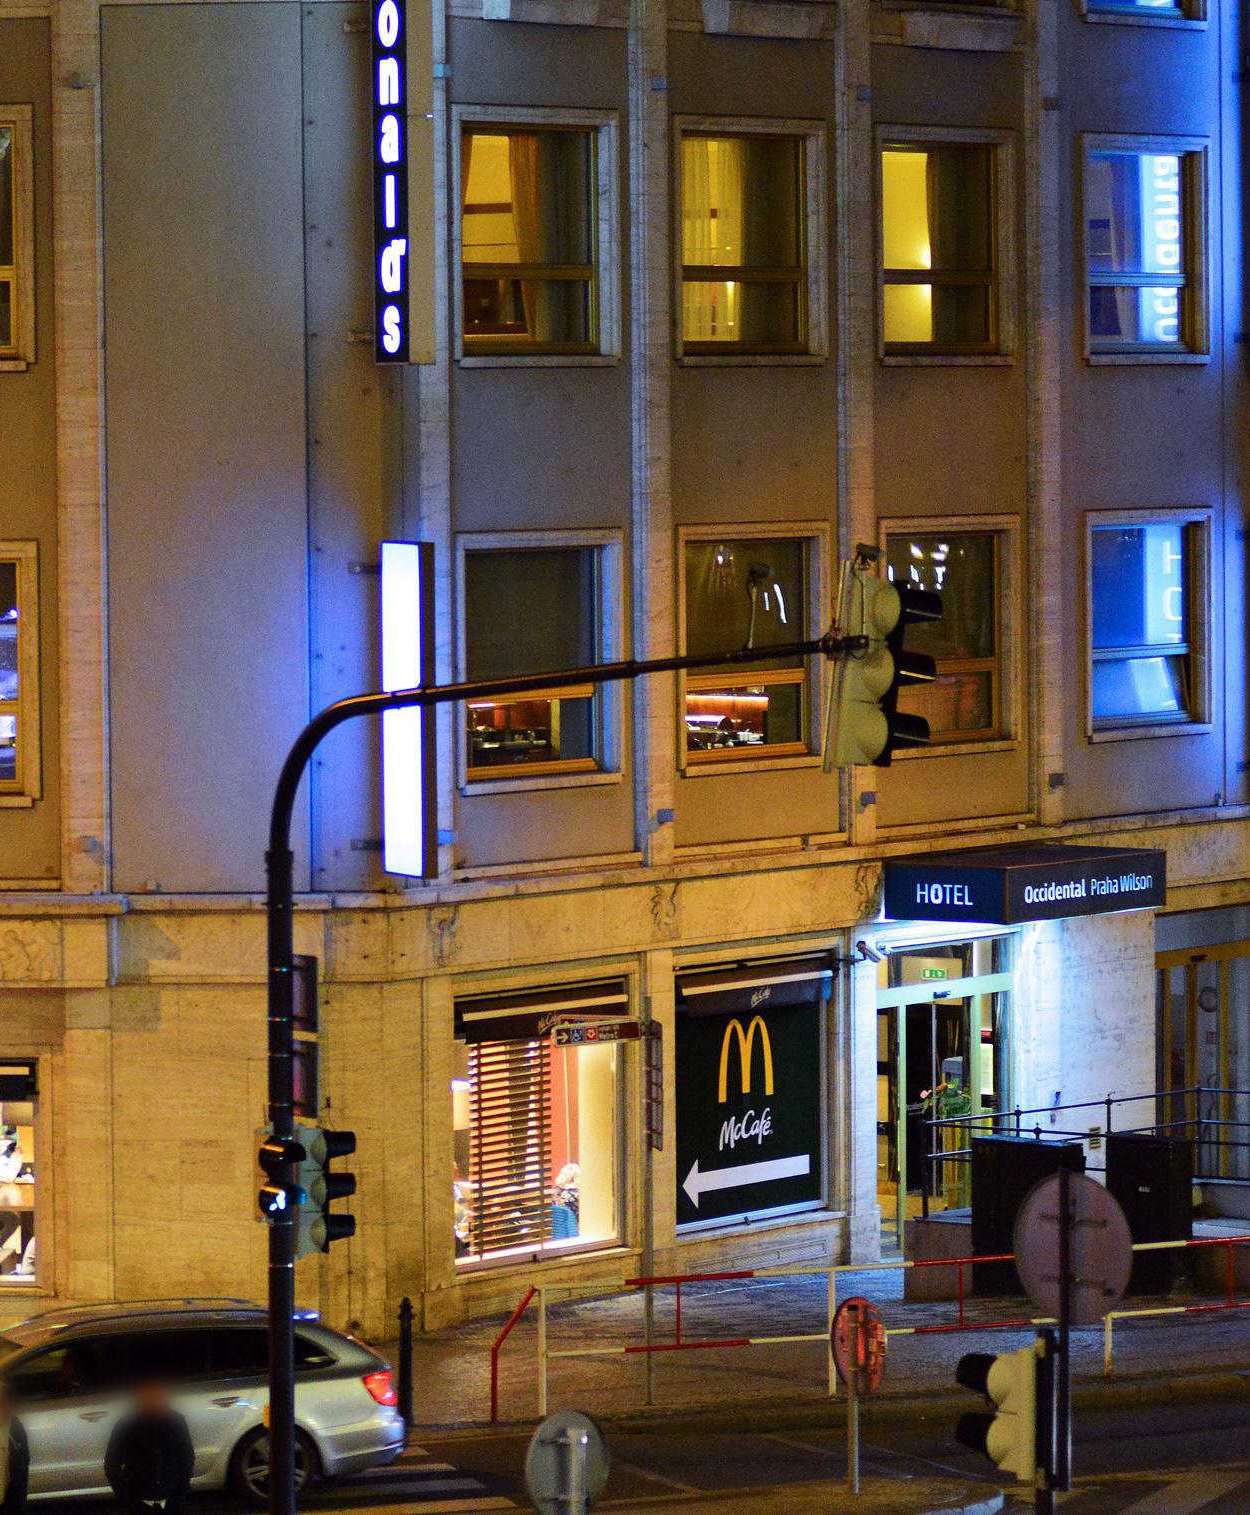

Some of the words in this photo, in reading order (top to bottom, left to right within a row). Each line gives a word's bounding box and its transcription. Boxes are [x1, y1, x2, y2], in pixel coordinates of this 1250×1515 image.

[916, 883, 974, 906] HOTEL
[1024, 881, 1086, 904] Occidental
[1090, 878, 1119, 896] Praha
[1119, 872, 1153, 892] Wilson
[719, 1107, 771, 1151] McCafé
